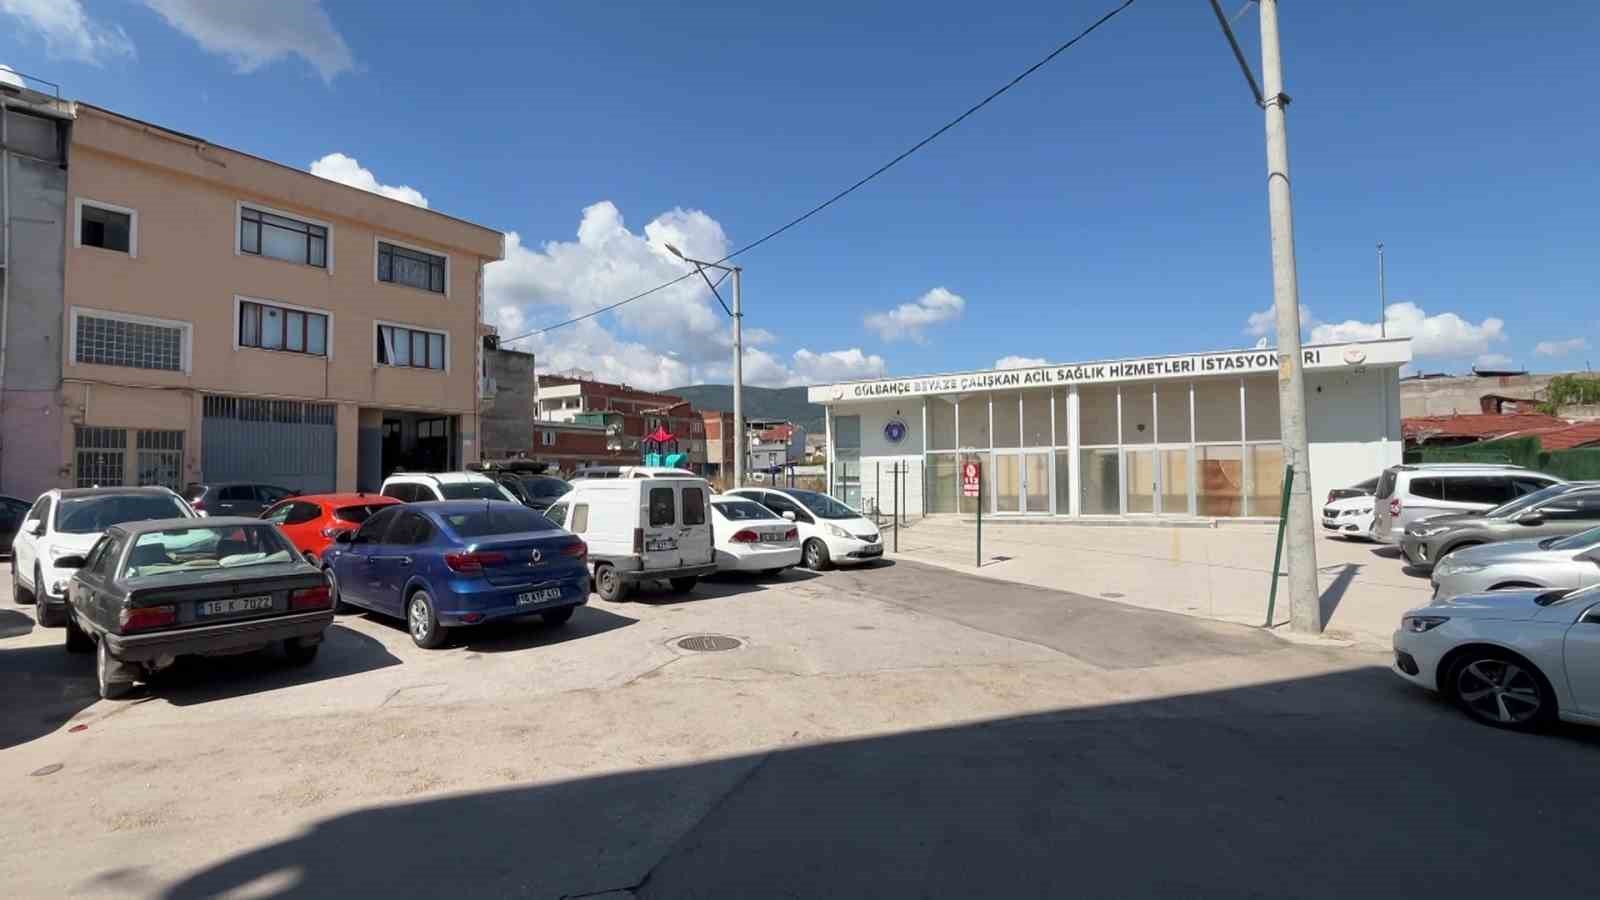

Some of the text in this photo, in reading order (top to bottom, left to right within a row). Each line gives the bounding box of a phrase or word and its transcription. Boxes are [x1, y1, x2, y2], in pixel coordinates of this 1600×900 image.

[1024, 369, 1053, 384] ACİL
[1057, 364, 1105, 381] SAĞLIK
[1110, 357, 1195, 377] HİZMETLERİ
